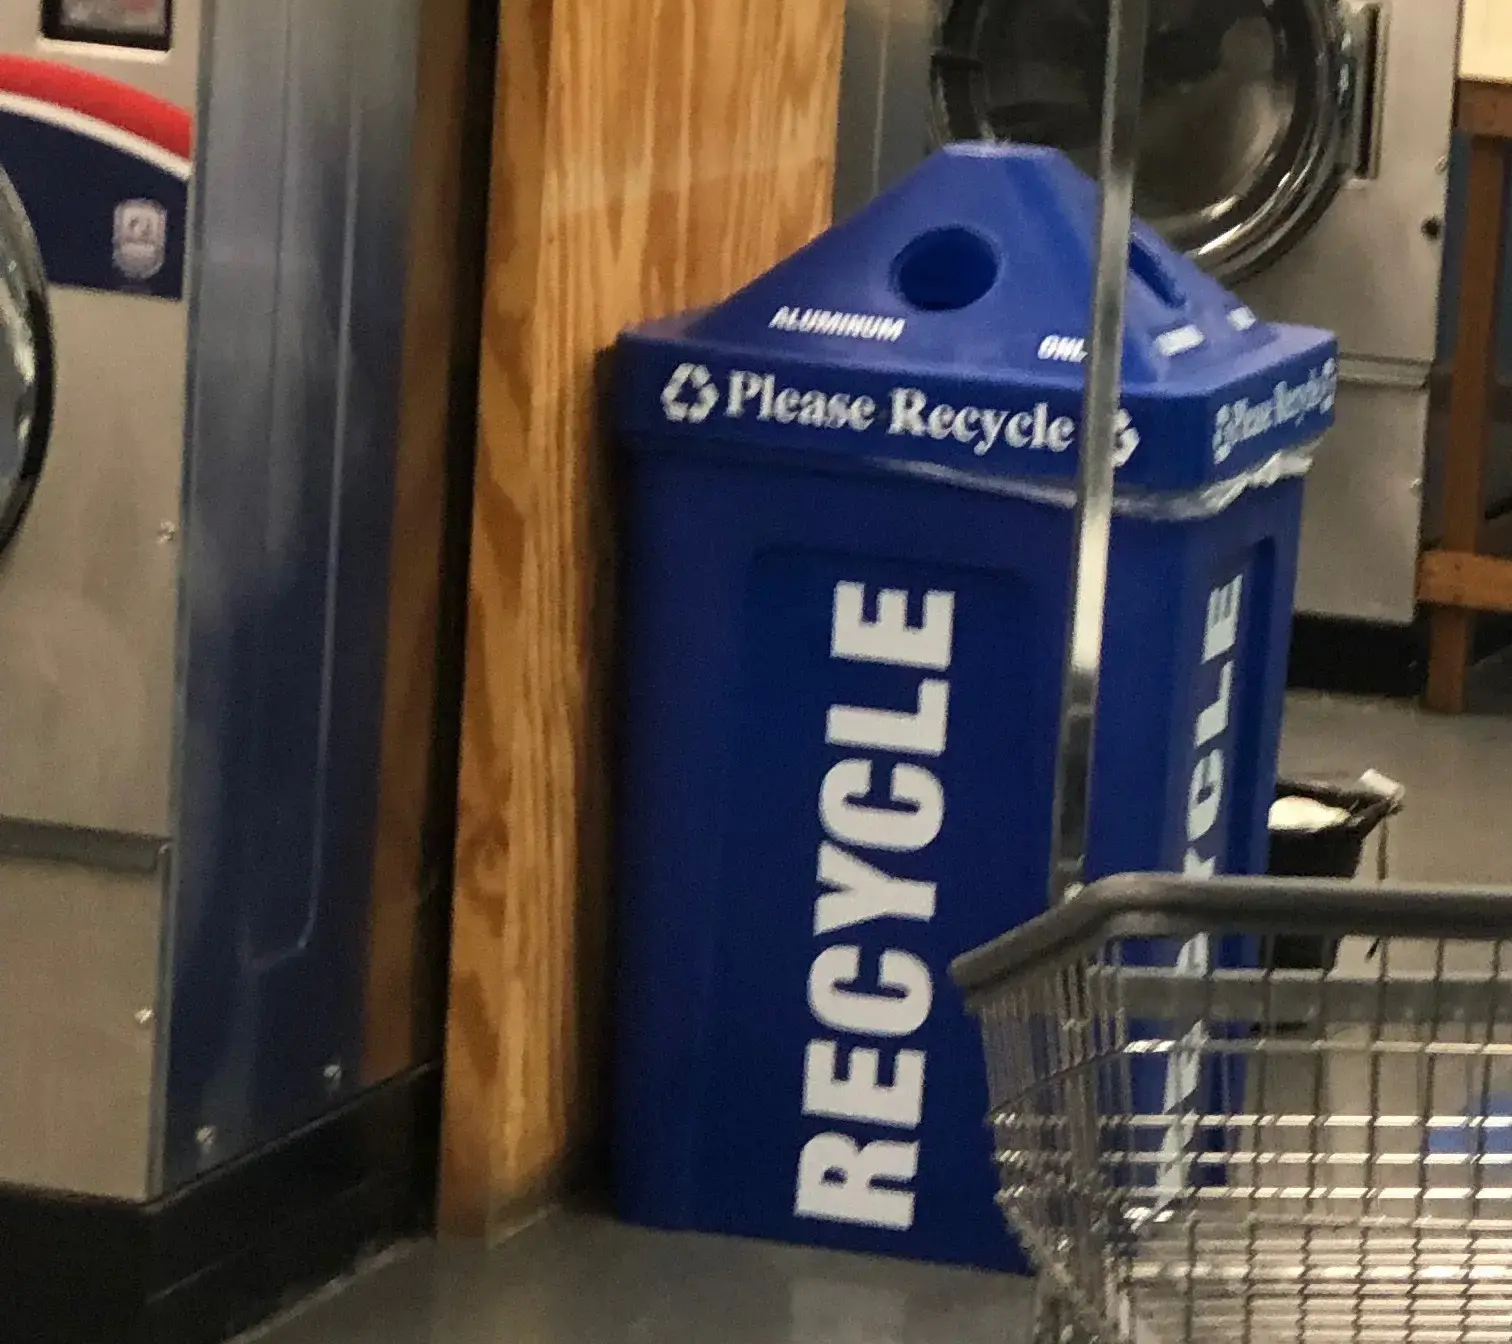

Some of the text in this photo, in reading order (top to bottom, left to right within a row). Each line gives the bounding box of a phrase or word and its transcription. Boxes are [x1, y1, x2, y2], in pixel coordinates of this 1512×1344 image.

[768, 306, 906, 342] ALUMINUM
[725, 369, 1075, 456] Please Recycle
[793, 579, 956, 1232] RECYCLE
